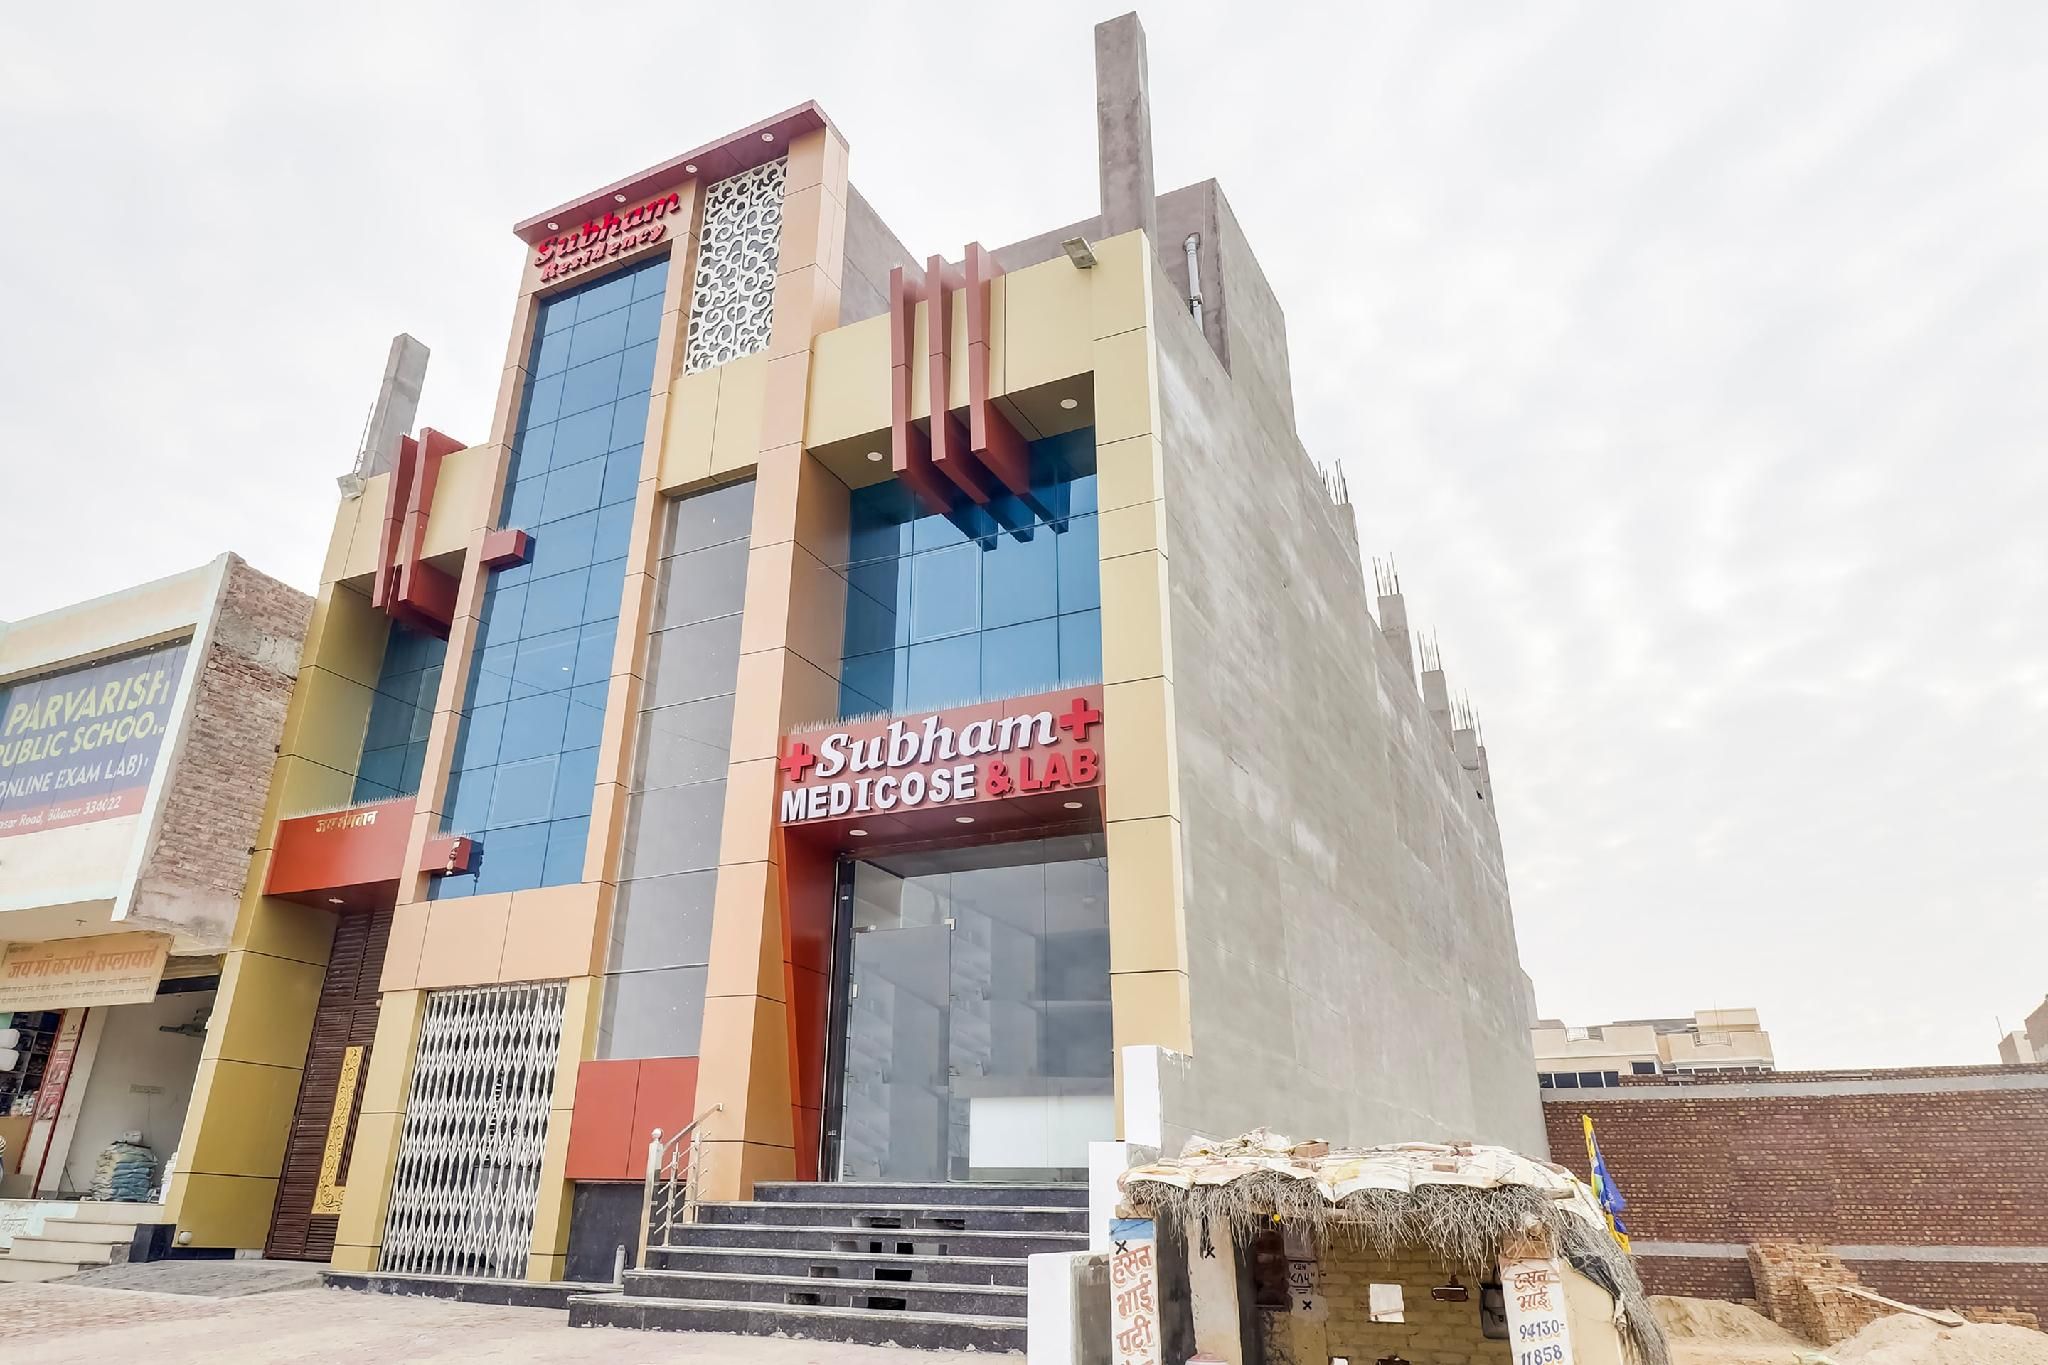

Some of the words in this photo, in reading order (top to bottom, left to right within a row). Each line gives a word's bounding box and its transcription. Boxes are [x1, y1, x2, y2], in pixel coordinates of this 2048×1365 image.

[535, 192, 681, 267] Subham
[540, 223, 666, 282] Residency
[815, 710, 1059, 779] Subham
[55, 761, 102, 790] EXAM
[781, 763, 977, 824] MEDICOSE
[985, 760, 1013, 796] &
[1019, 748, 1098, 793] LAB
[1116, 1273, 1155, 1317] भाई
[1516, 1285, 1549, 1309] भाई
[1521, 1344, 1563, 1365] 11858
